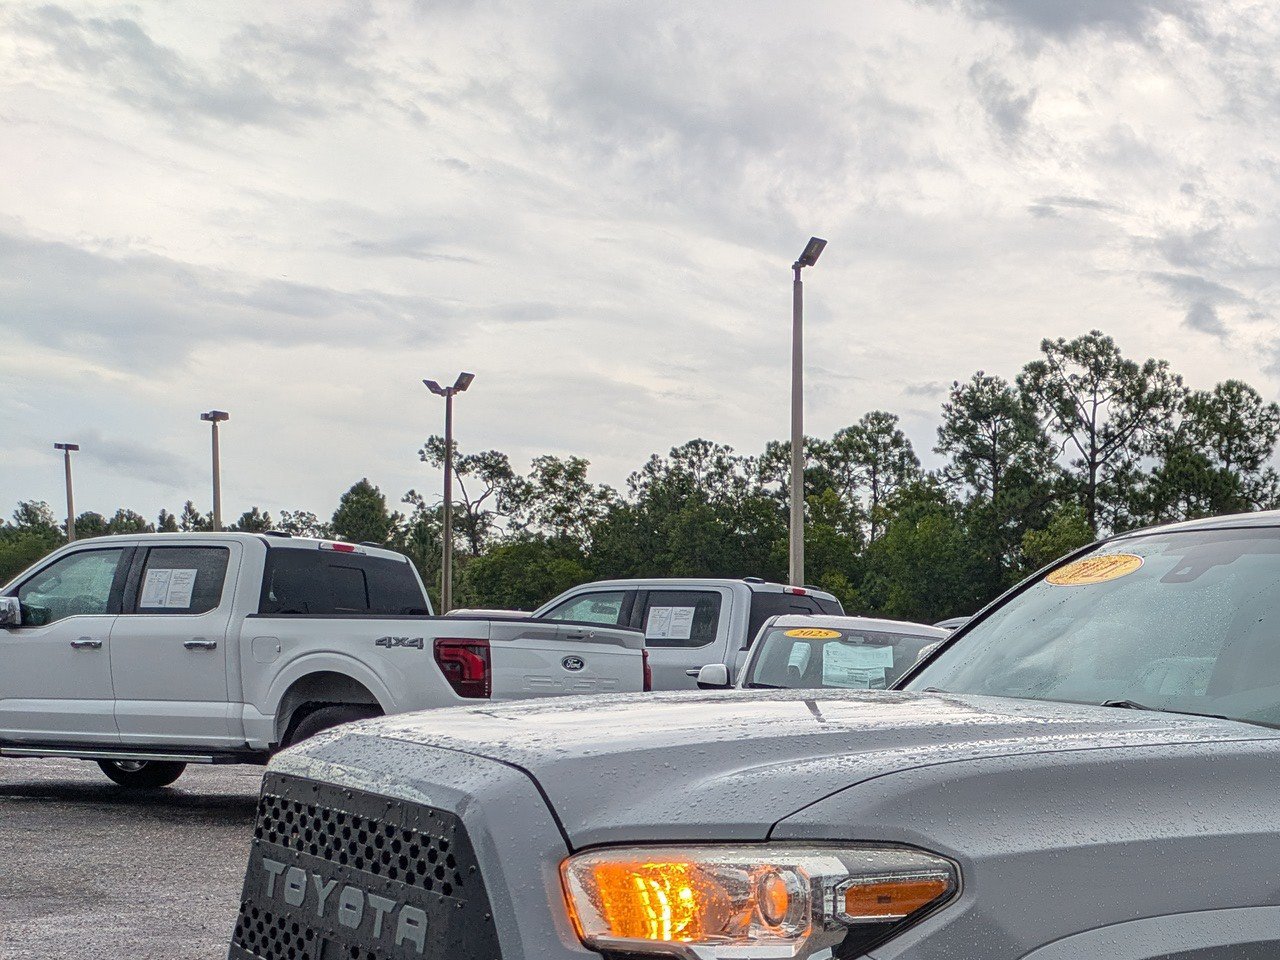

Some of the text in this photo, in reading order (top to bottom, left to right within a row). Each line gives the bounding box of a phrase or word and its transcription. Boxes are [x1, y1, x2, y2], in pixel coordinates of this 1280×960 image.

[795, 629, 833, 638] 2025
[522, 674, 620, 692] F-150
[262, 857, 429, 955] TOYOTA
